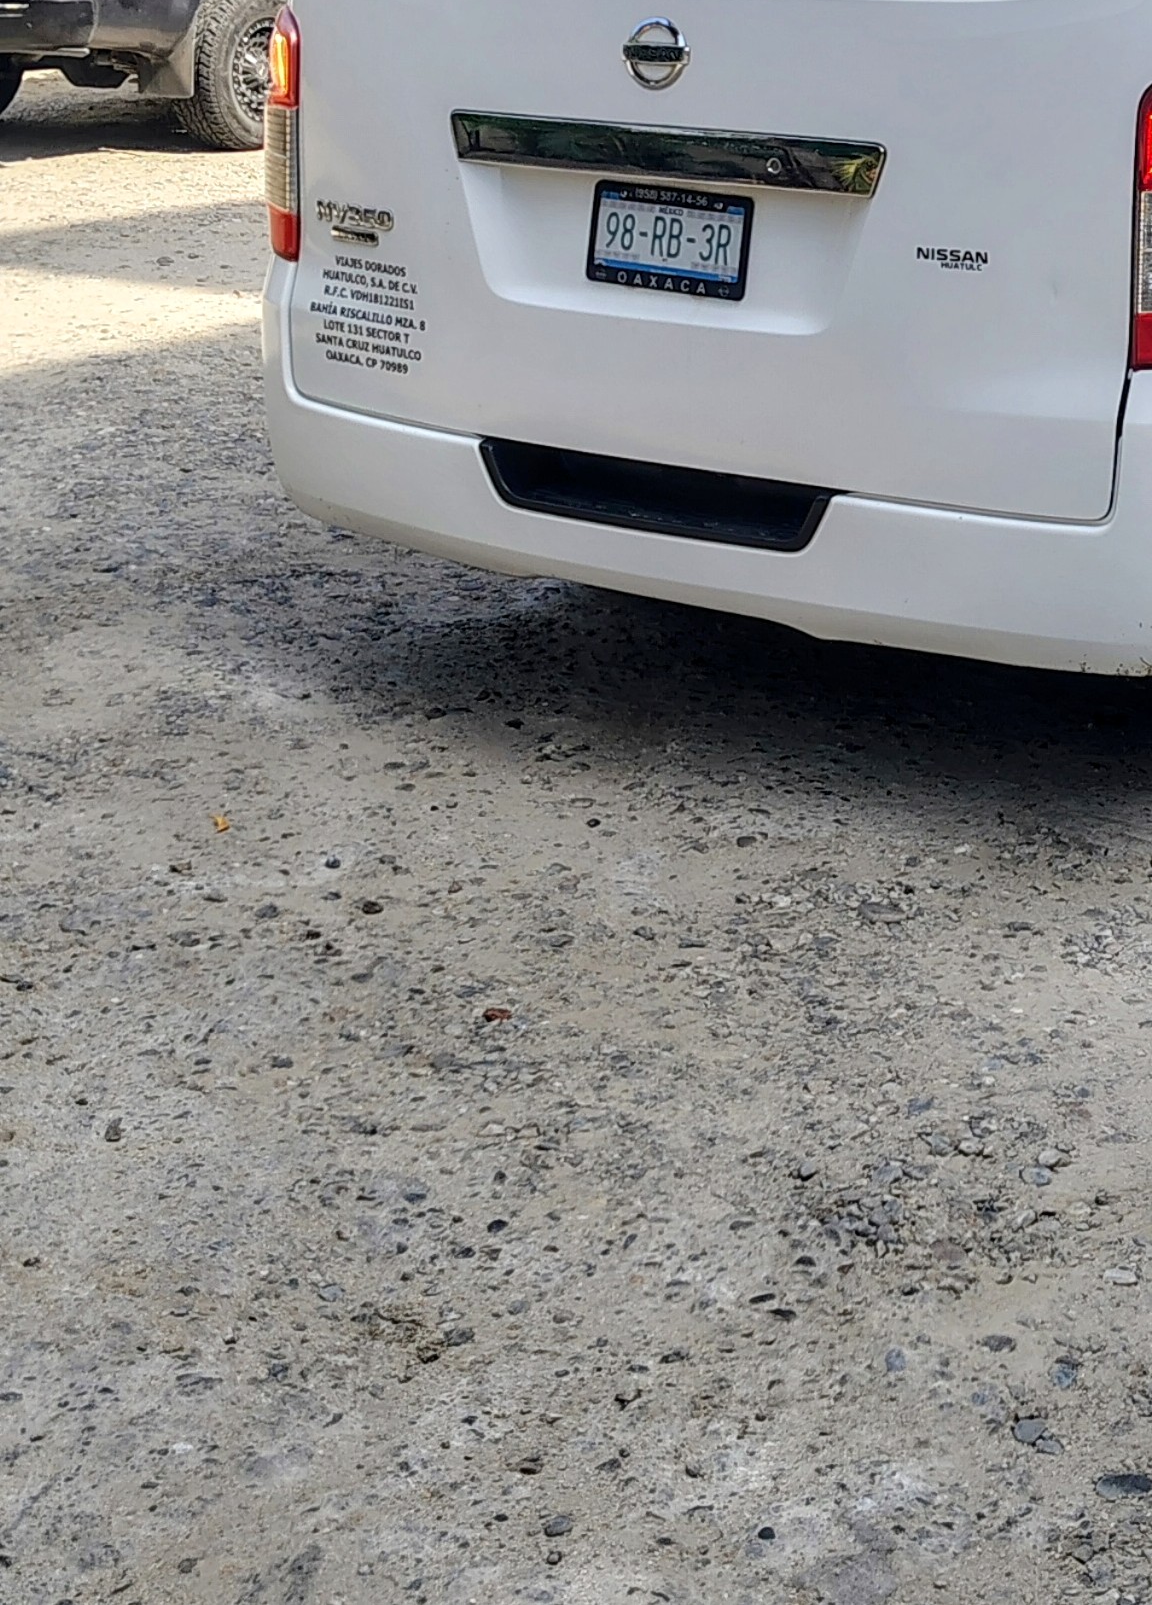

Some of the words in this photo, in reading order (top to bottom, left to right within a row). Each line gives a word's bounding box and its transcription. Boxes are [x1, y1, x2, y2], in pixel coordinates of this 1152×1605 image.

[606, 212, 731, 266] 98-RB-3R
[336, 256, 362, 270] VIAJES
[365, 260, 406, 277] DORADOS
[916, 247, 988, 264] NISSAN
[323, 269, 368, 288] HUATULCO,
[389, 280, 400, 292] DE
[402, 282, 418, 294] C.V.
[617, 271, 706, 294] OAXACA
[310, 300, 337, 314] BAHÍA
[395, 316, 417, 330] MZA.
[324, 319, 345, 332] LOTE
[348, 324, 363, 336] 131
[366, 326, 402, 342] SECTOR
[404, 332, 410, 344] T
[316, 333, 344, 347] SANTA
[346, 338, 370, 352] CRUZ
[372, 343, 422, 361] HUATULCO
[366, 357, 377, 369] CP
[380, 360, 408, 374] 70989
